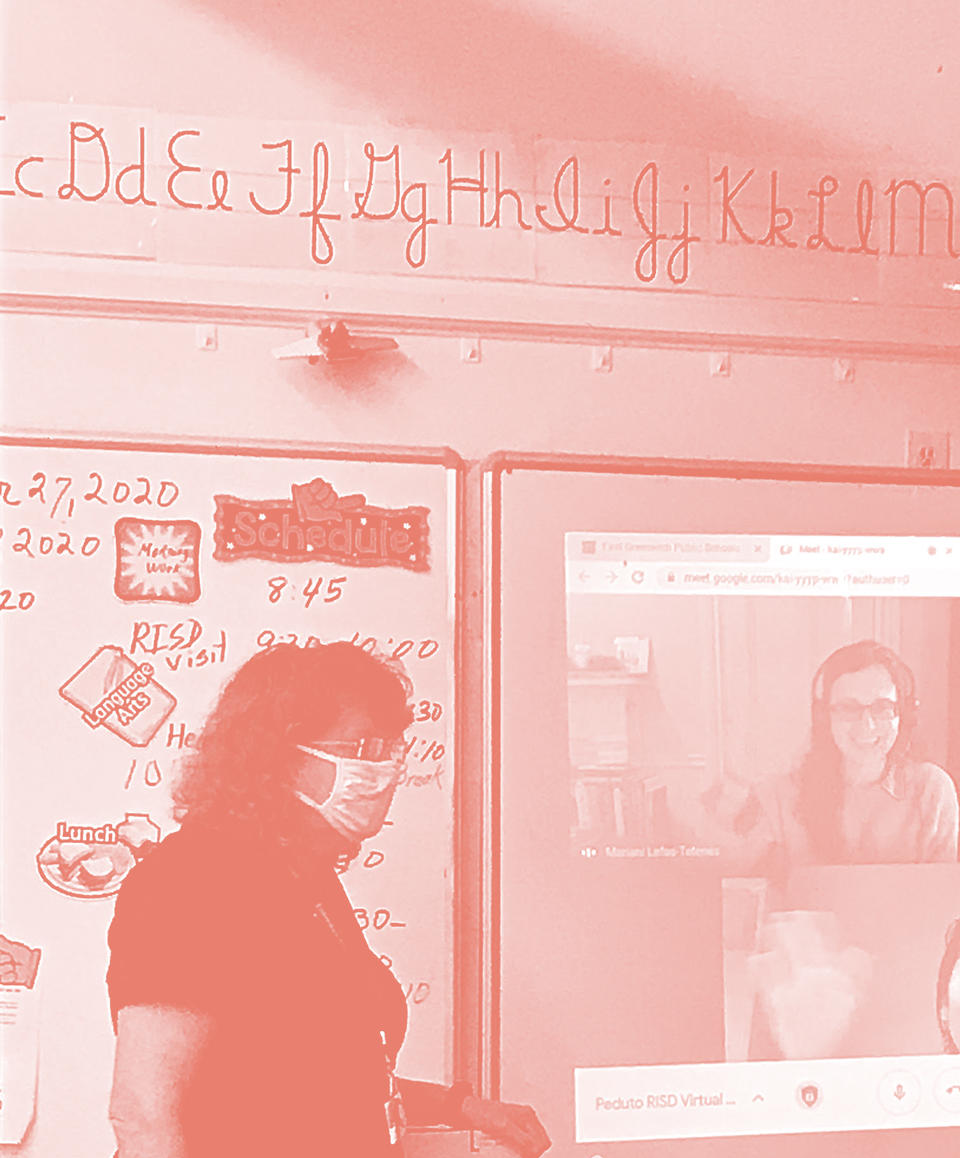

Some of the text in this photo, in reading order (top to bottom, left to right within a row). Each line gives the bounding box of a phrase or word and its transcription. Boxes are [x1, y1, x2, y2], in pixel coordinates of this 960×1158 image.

[58, 121, 157, 208] Dd
[167, 131, 233, 211] Ee
[438, 148, 532, 229] Hh
[713, 165, 798, 249] Kk
[12, 527, 101, 559] 2020
[232, 510, 415, 556] Schedule
[267, 576, 347, 608] 8:45
[129, 617, 203, 655] RISD
[165, 629, 227, 671] visit
[82, 663, 154, 728] Language
[116, 692, 151, 726] Arts
[58, 822, 117, 843] Lunch
[594, 1095, 644, 1112] Peduto
[646, 1093, 679, 1110] RISD
[679, 1091, 724, 1108] Virtual
